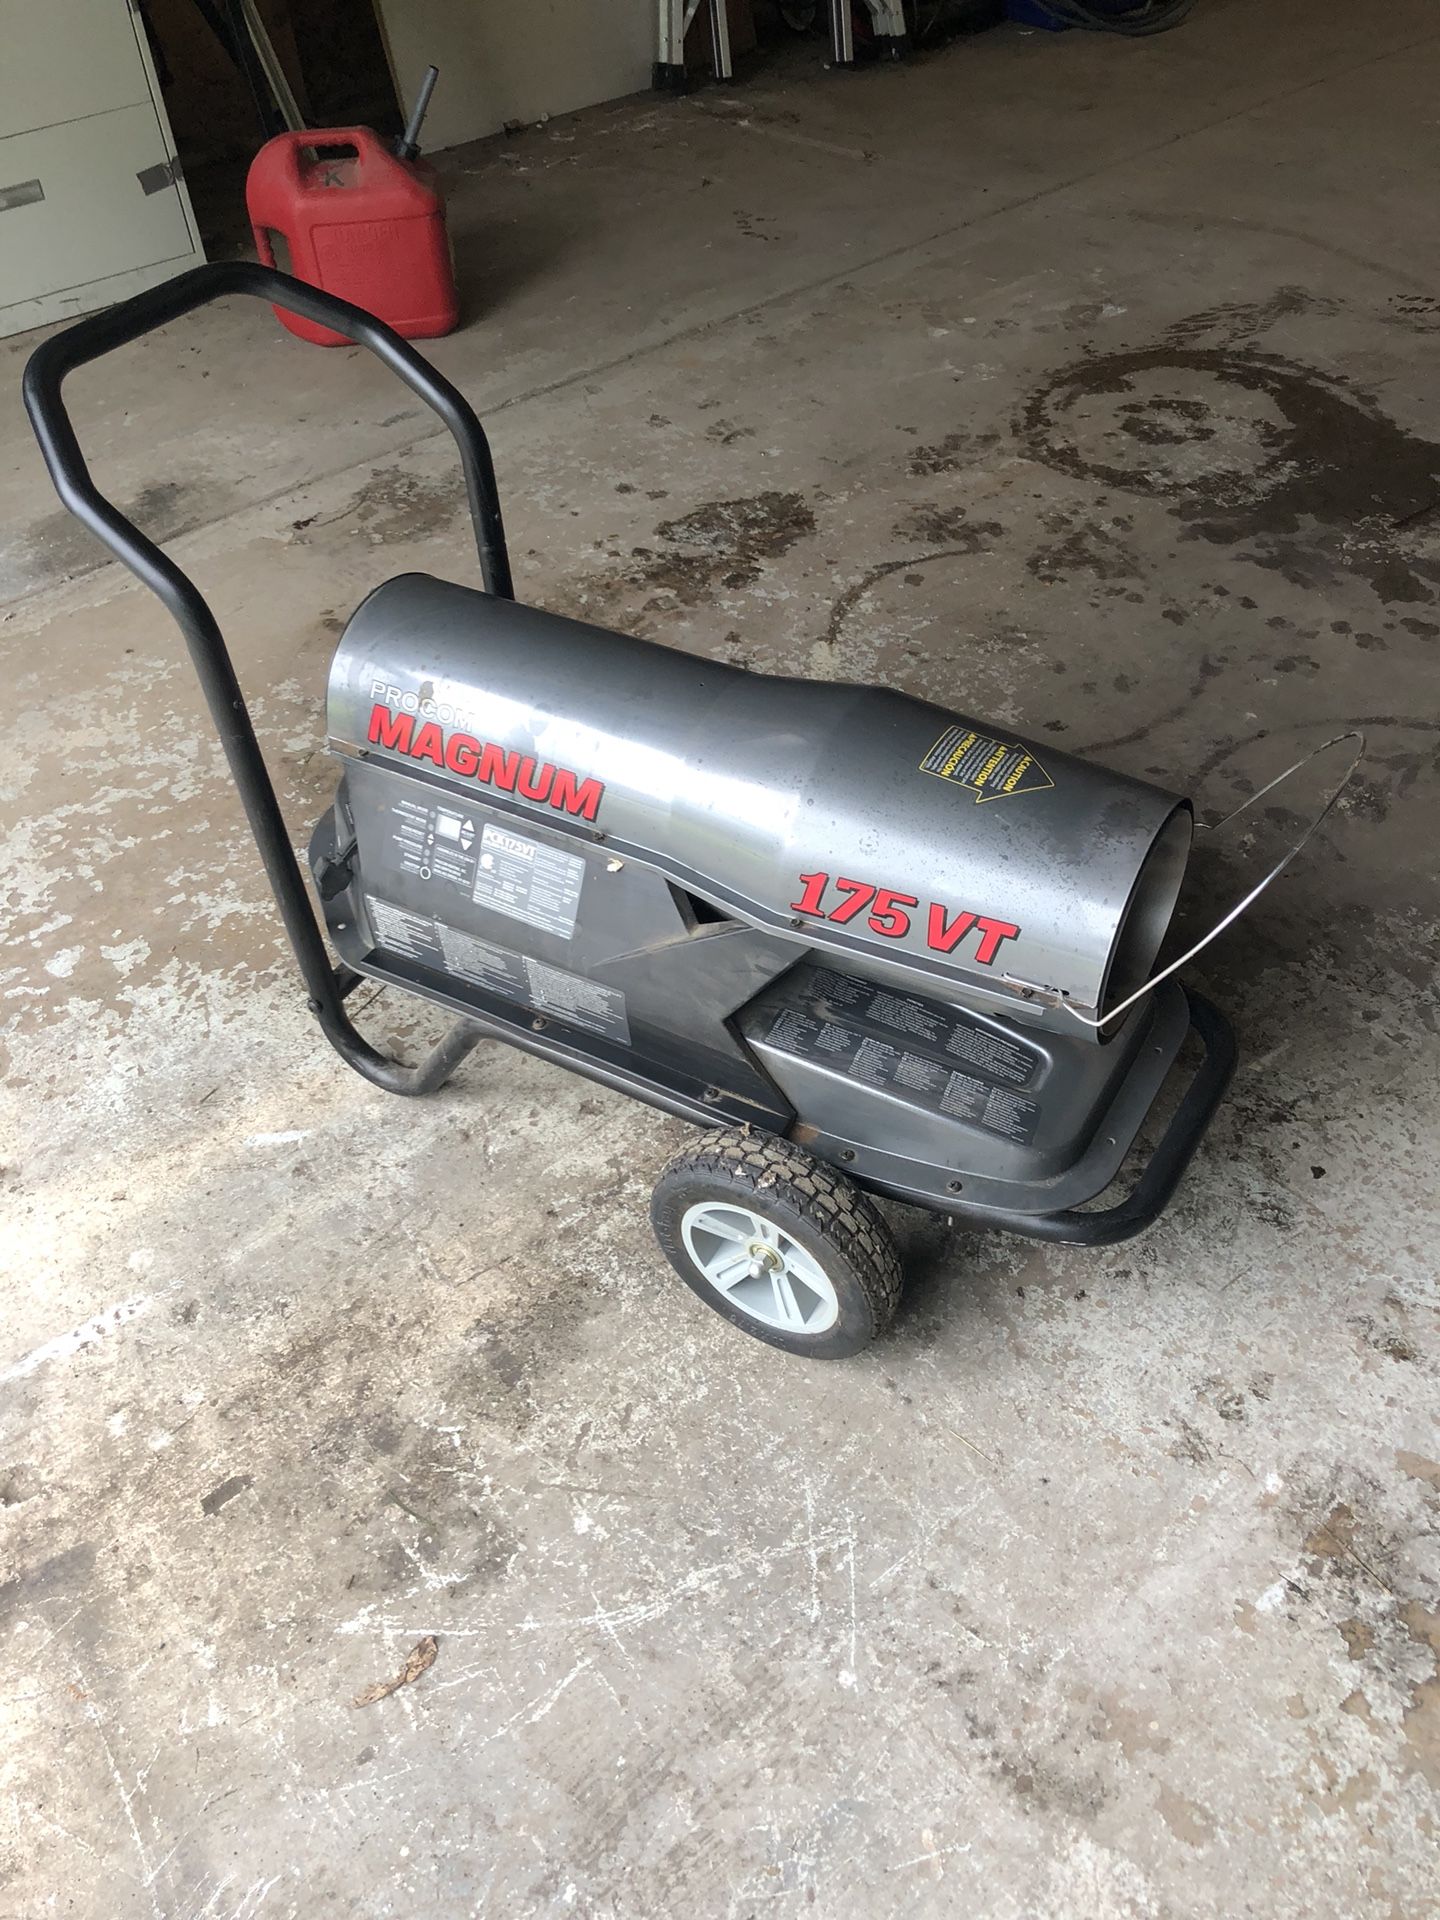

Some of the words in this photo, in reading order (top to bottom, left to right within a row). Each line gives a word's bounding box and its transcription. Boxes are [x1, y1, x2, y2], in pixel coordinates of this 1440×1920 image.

[325, 171, 344, 187] K
[370, 679, 475, 733] PROCOM
[367, 703, 606, 823] MAGNUM
[974, 748, 1005, 787] ATTENTION
[1003, 760, 1030, 792] CAUTION
[790, 872, 920, 939] 175
[927, 902, 1022, 966] VT
